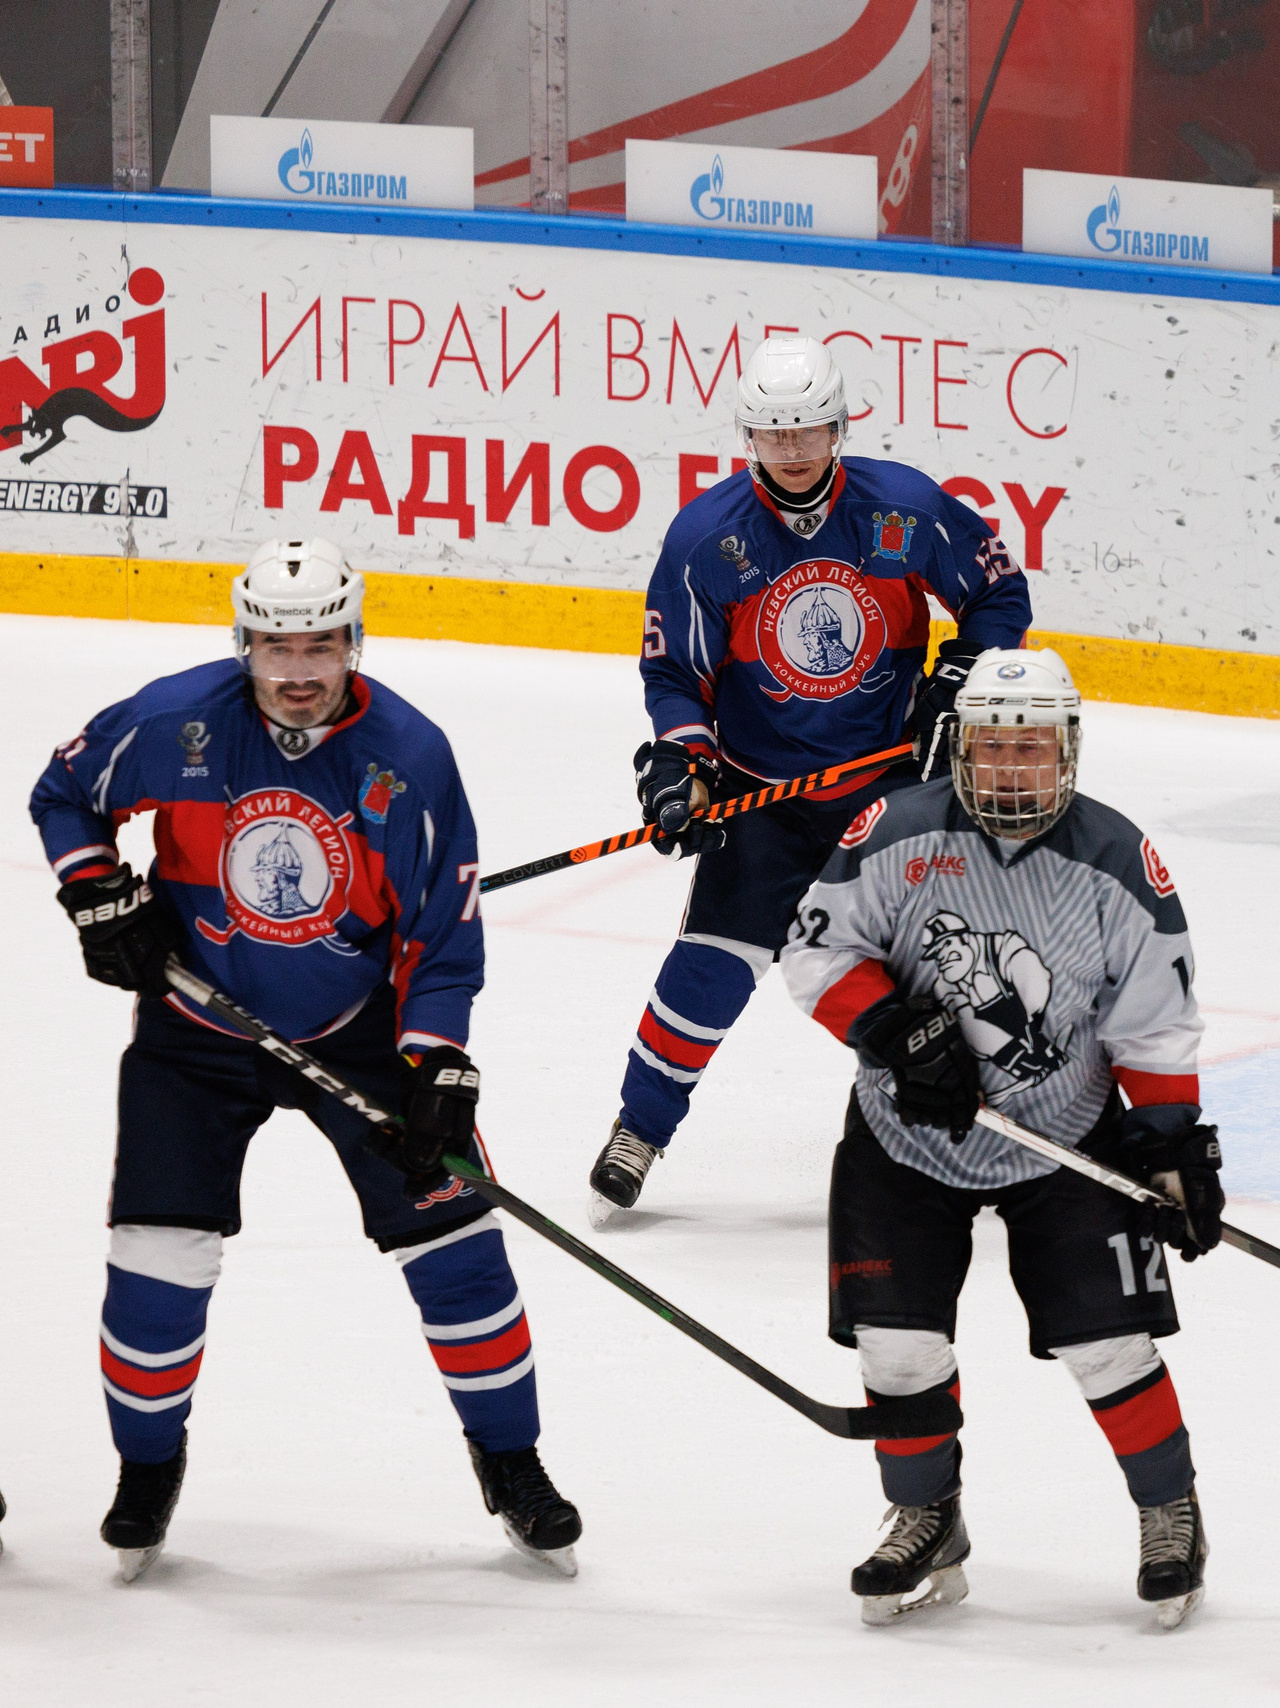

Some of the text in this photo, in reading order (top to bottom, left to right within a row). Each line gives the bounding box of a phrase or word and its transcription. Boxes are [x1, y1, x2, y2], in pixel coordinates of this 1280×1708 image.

[317, 170, 407, 200] ГАЗПРОМ
[725, 200, 813, 229] ГАЗПРОМ
[1123, 230, 1209, 262] ГАЗПРОМ
[13, 295, 121, 345] АДИО
[261, 287, 1068, 440] ИГРАЙ ВМСТЕ С
[263, 425, 640, 540] РАДИО
[738, 565, 761, 584] 2015
[273, 606, 313, 617] Reebok
[763, 563, 820, 633] НЕВСКИЙ
[773, 661, 848, 694] ХОККЕЙНЫЙ
[181, 766, 210, 778] 2015
[297, 805, 345, 880] ЛЕГИОН
[502, 854, 565, 884] COVERT
[74, 884, 154, 928] BAUE
[257, 1035, 390, 1123] CCM
[1107, 1232, 1168, 1297] 12
